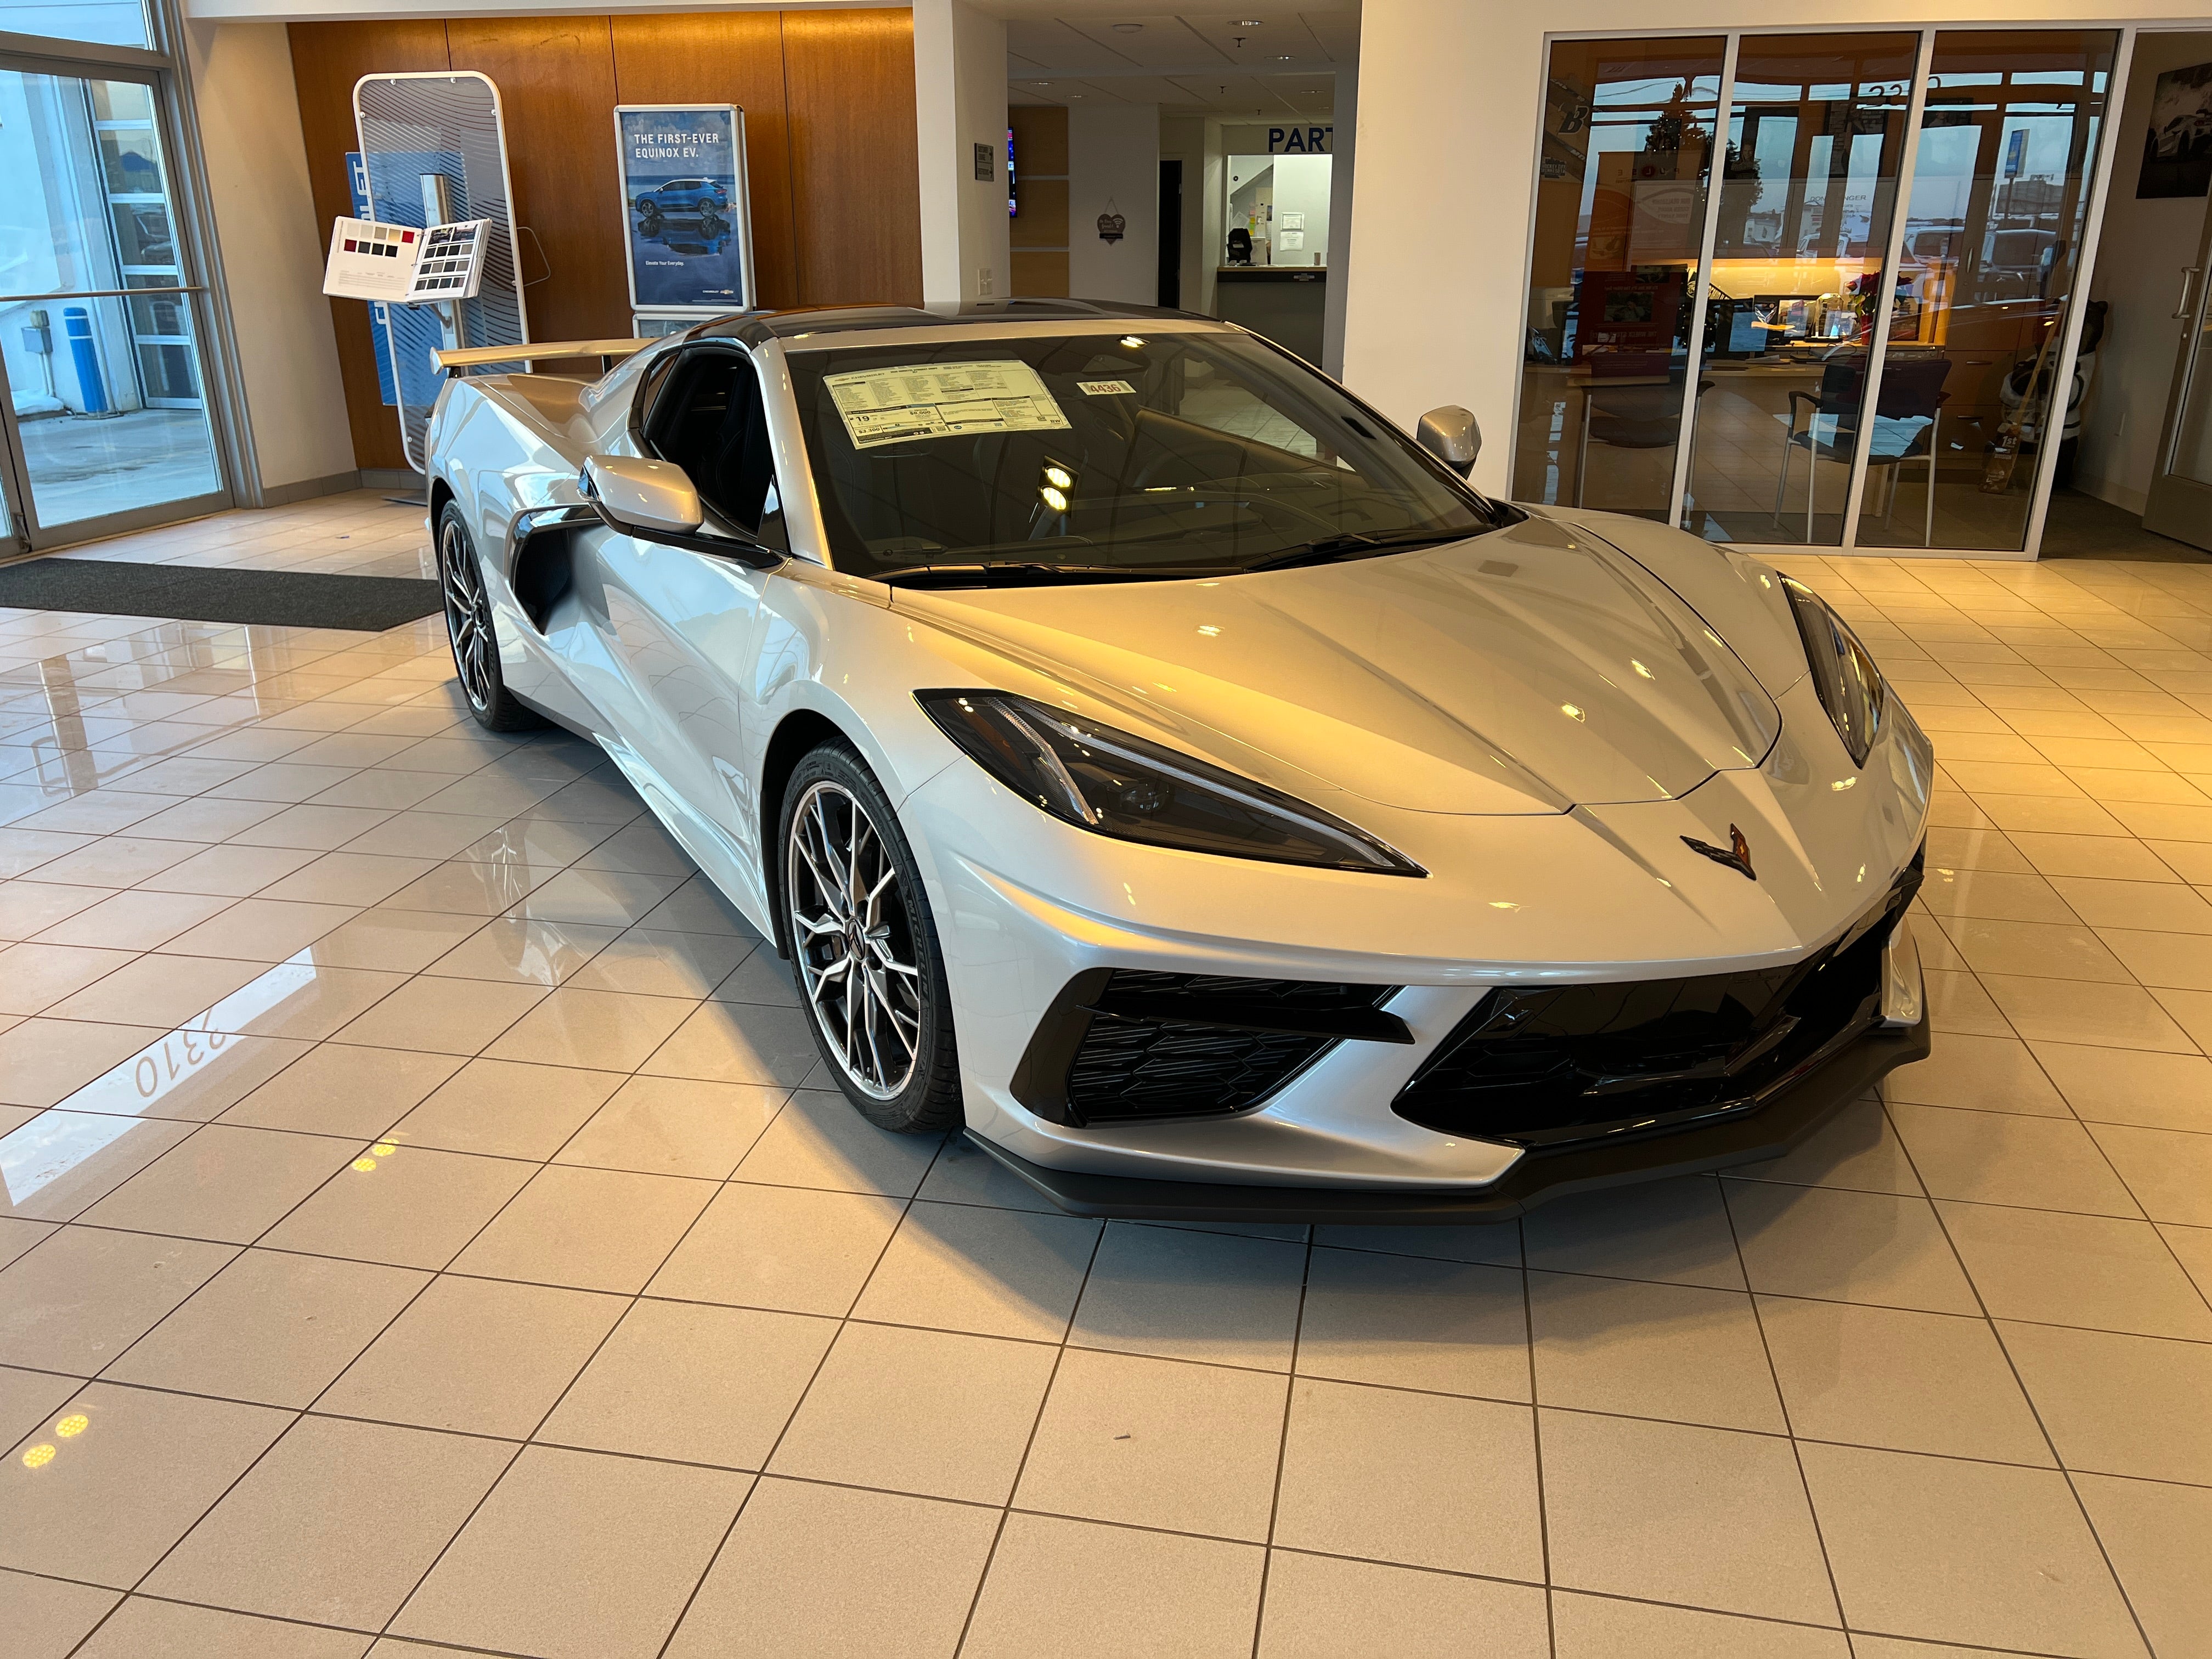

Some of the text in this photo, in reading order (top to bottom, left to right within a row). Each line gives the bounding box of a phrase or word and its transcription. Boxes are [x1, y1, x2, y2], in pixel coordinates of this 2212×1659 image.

[634, 133, 719, 144] THE FIRST-EVER
[635, 148, 698, 159] EQUINOX EV.
[1090, 384, 1121, 392] 4436
[2002, 436, 2017, 447] 1st
[907, 899, 928, 997] MICHELIN
